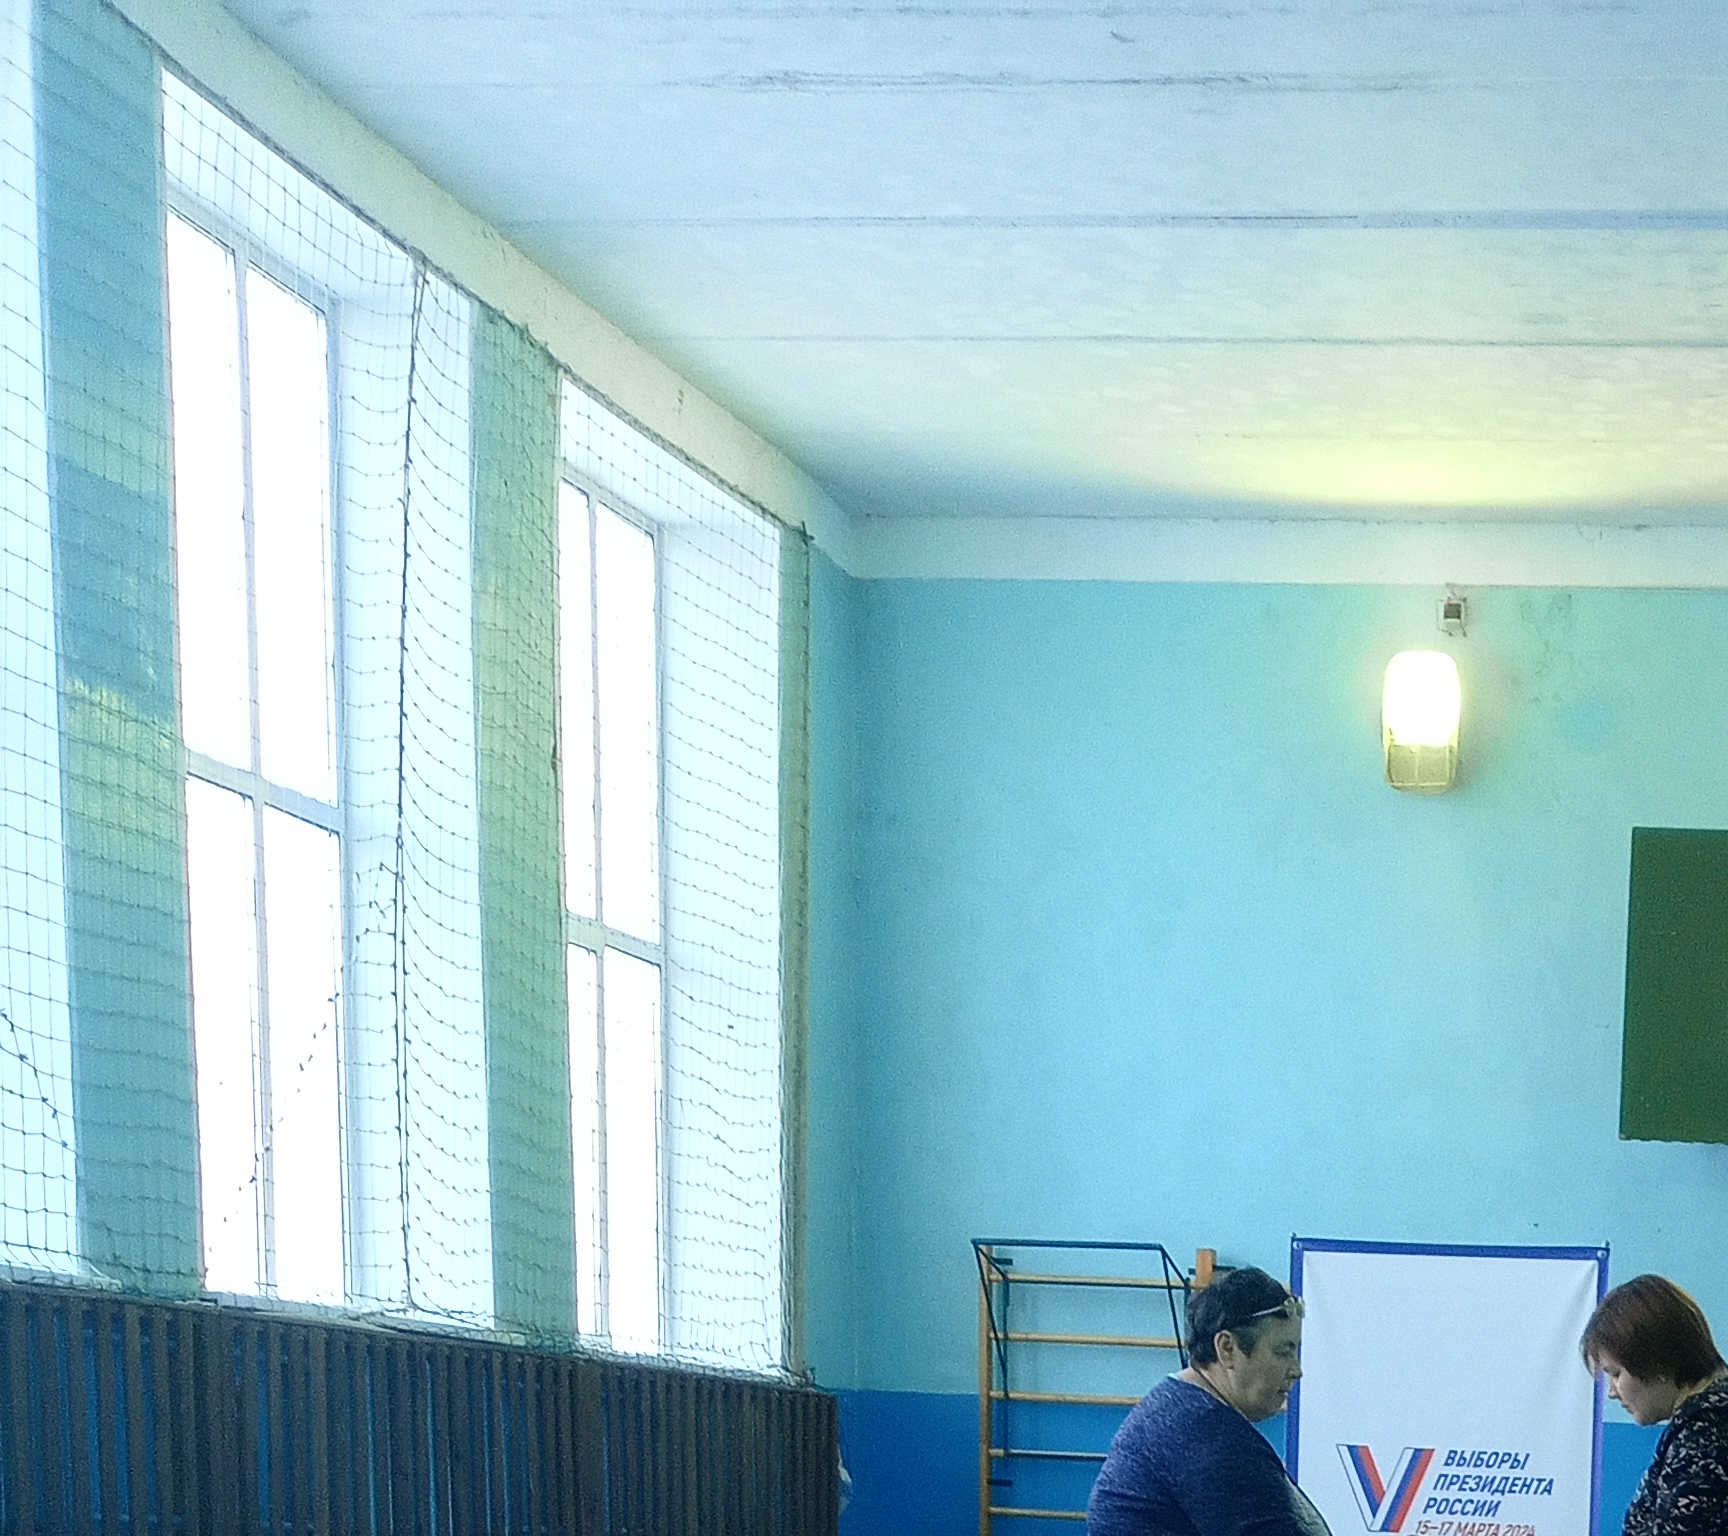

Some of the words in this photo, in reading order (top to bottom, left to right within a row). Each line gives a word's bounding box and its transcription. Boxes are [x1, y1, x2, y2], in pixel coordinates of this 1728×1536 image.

[1443, 1449, 1530, 1470] ВЫБОРЫ
[1432, 1473, 1554, 1496] ПРЕЗИДЕНТА
[1422, 1497, 1502, 1517] РОССИИ
